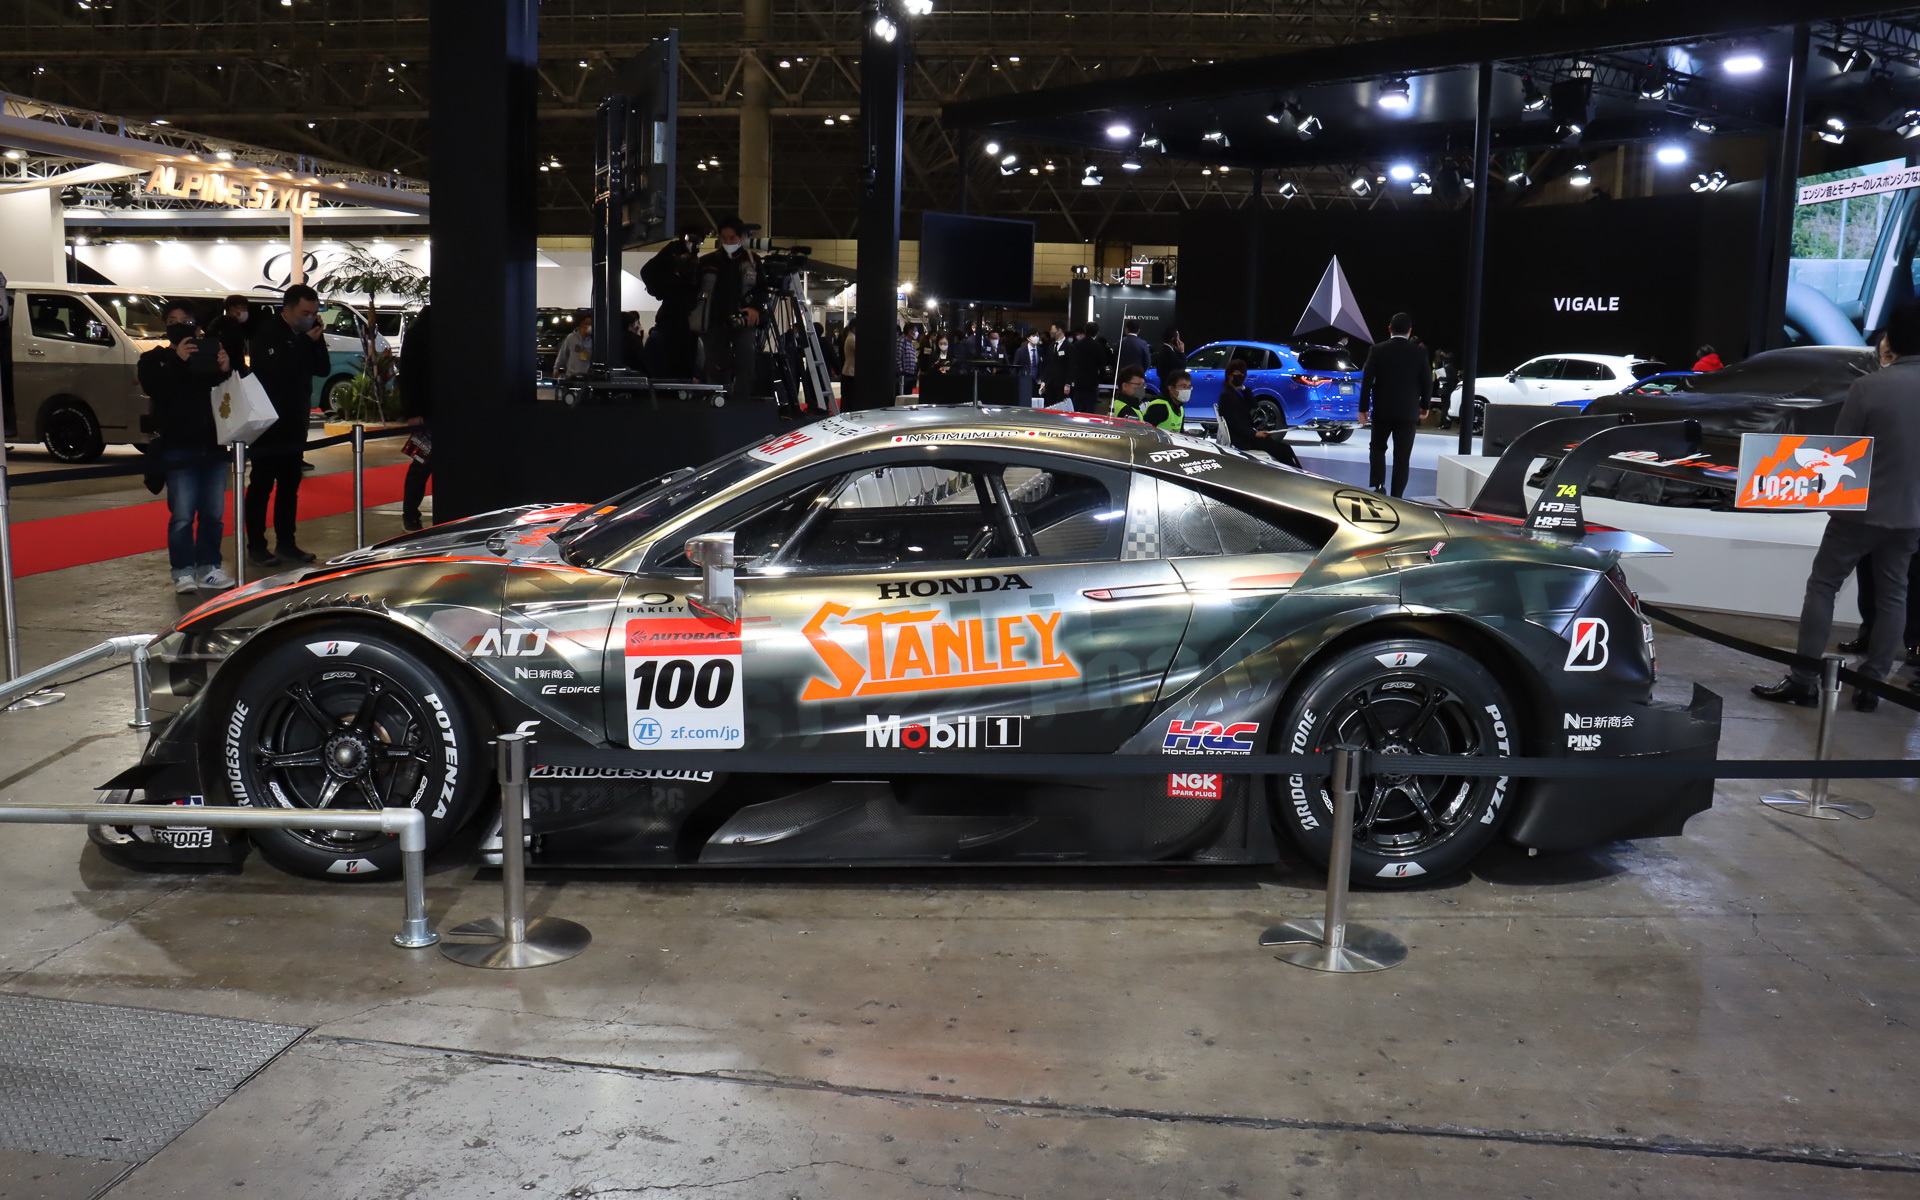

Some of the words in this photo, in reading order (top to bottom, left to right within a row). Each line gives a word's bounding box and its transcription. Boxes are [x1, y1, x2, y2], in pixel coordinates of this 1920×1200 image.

[145, 164, 243, 206] ALPINE
[246, 181, 320, 217] STYLE
[1802, 171, 1920, 201] エンジン音とモーターのレスポンシブな
[1553, 296, 1621, 312] VIGALE
[1149, 449, 1190, 463] DyDo
[1556, 484, 1577, 498] 74
[877, 573, 1032, 600] HONDA
[627, 606, 684, 614] OAKLEY
[472, 628, 549, 657] ATJ
[649, 631, 737, 642] AUTOBACS
[800, 601, 1081, 702] STANLEY
[559, 685, 601, 694] EDIFICE
[633, 658, 735, 711] 100
[634, 722, 662, 741] ZF
[670, 726, 740, 742] zf.com/jp
[864, 714, 977, 749] Mobil
[1162, 719, 1260, 752] HRC
[1567, 734, 1602, 748] PINS
[226, 700, 253, 807] RIDGESTONE
[424, 693, 458, 819] POTENZA
[1162, 748, 1204, 756] Honda
[1480, 704, 1511, 825] POTNZA
[1171, 773, 1218, 791] NGK
[1289, 708, 1320, 831] BRIDGTONE
[1172, 789, 1194, 797] SPARK
[1195, 790, 1217, 798] PLUGS
